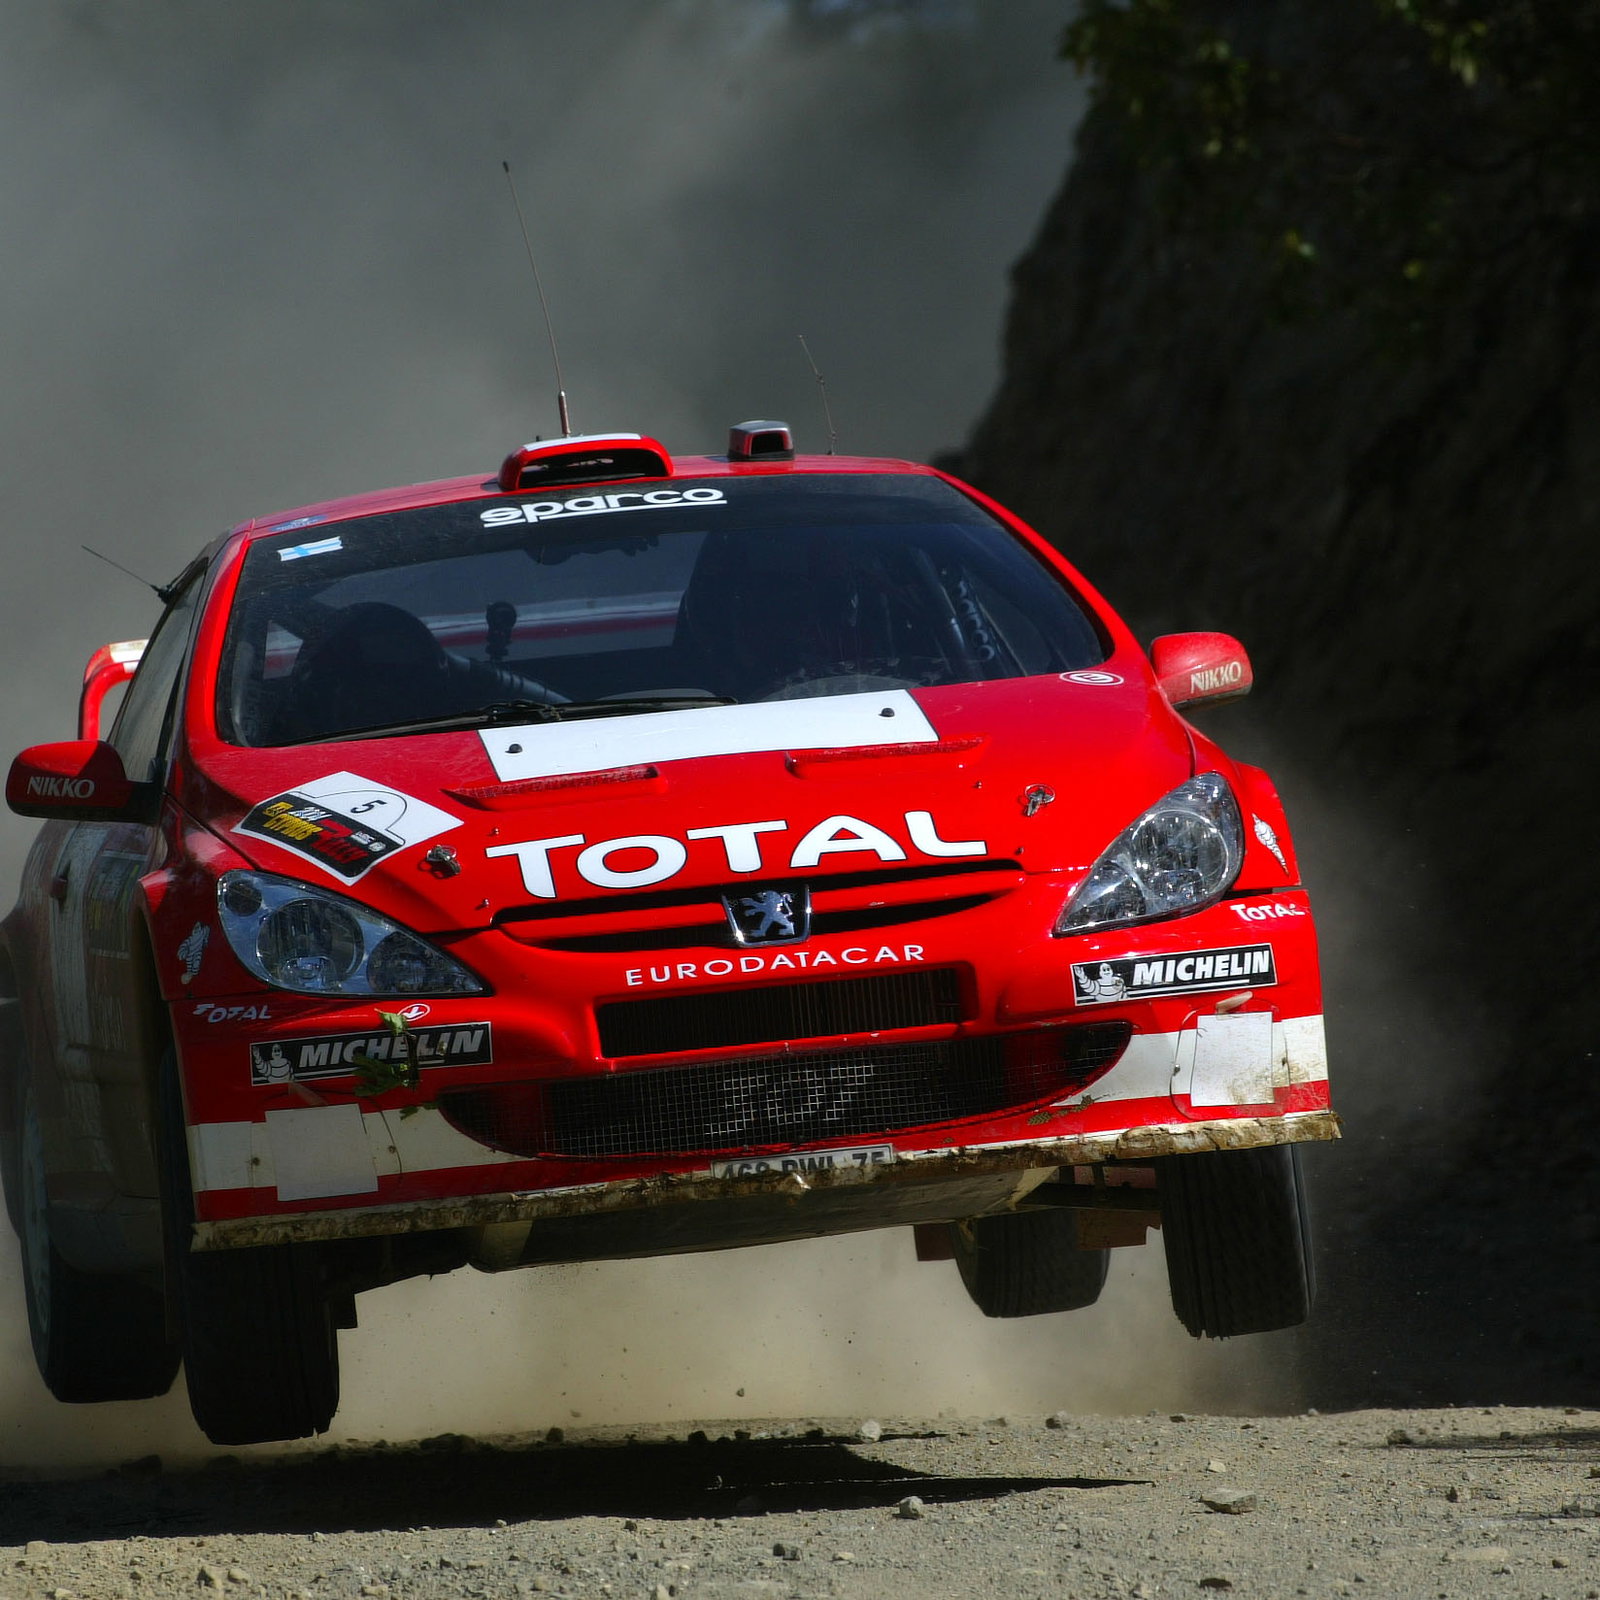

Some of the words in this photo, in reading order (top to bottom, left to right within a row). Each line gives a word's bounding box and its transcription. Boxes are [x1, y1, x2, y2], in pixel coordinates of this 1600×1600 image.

[480, 488, 725, 525] sparco
[1190, 661, 1242, 694] NIKKO
[27, 776, 95, 799] NIKKO
[350, 799, 387, 814] 5
[485, 811, 988, 898] TOTAL
[625, 944, 925, 987] EURODATACAR
[1132, 950, 1270, 986] MICHELIN
[193, 1003, 272, 1023] TOTAL
